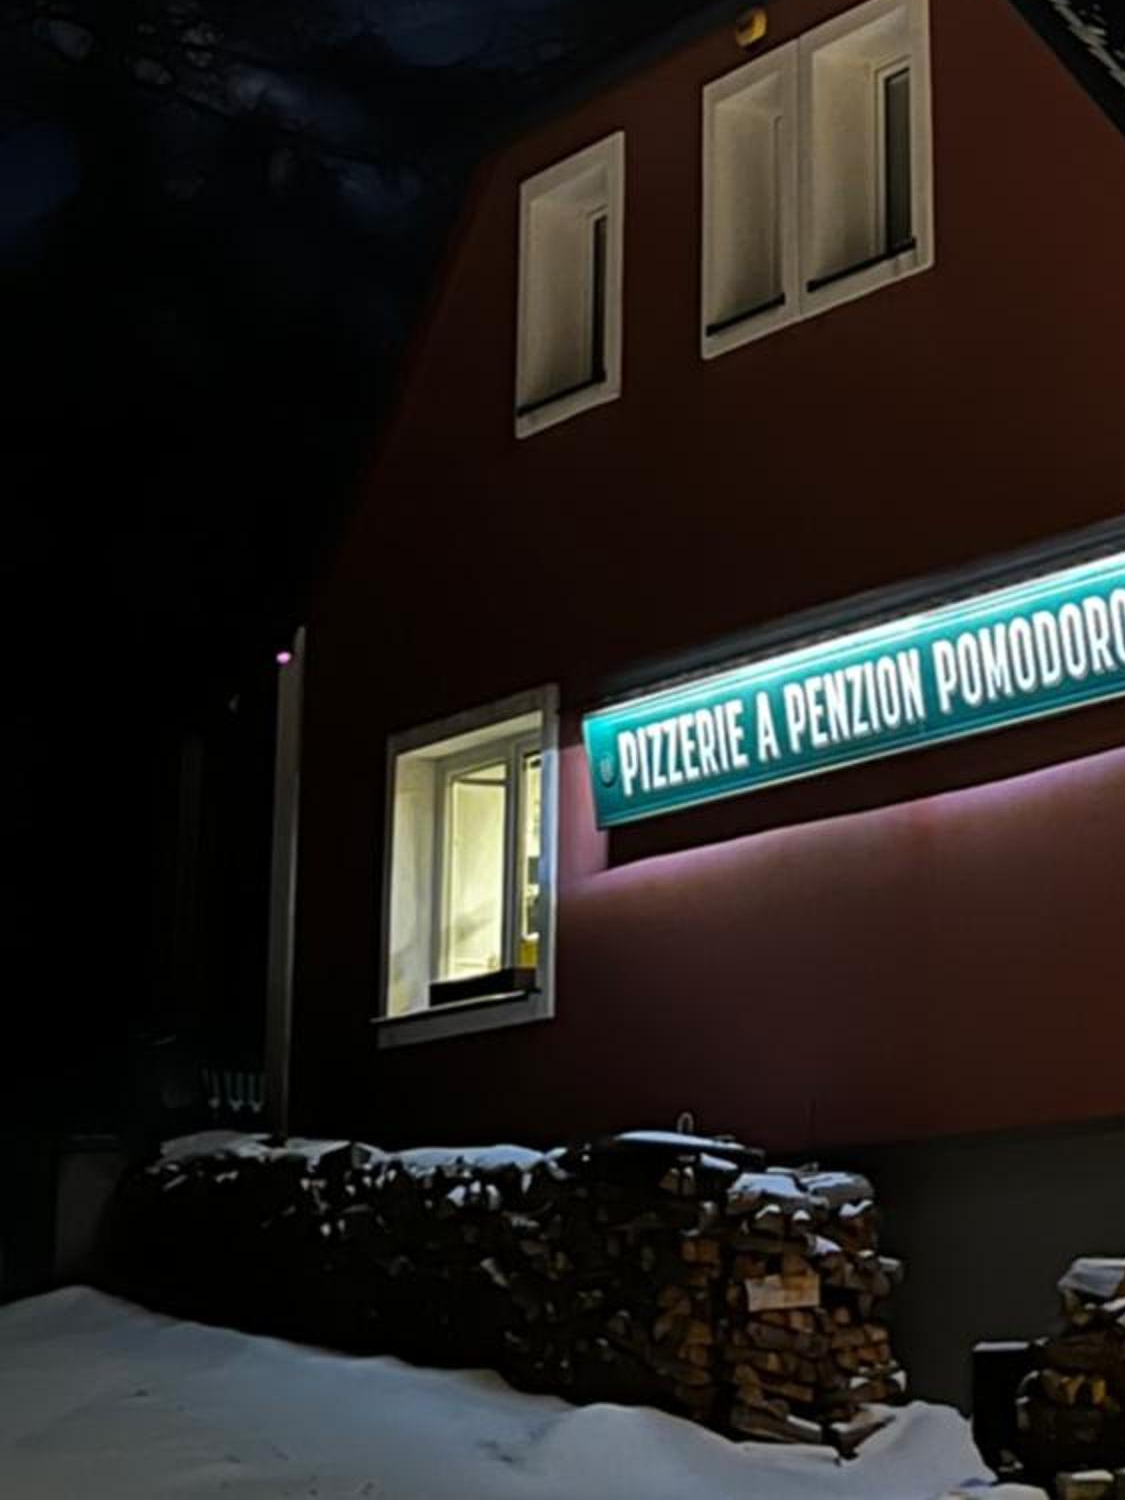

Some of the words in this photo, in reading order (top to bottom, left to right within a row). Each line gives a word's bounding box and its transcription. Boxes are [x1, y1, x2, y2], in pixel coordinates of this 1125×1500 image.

[617, 698, 749, 797] PIZZERIE
[755, 690, 780, 763] A
[783, 648, 926, 754] PENZION
